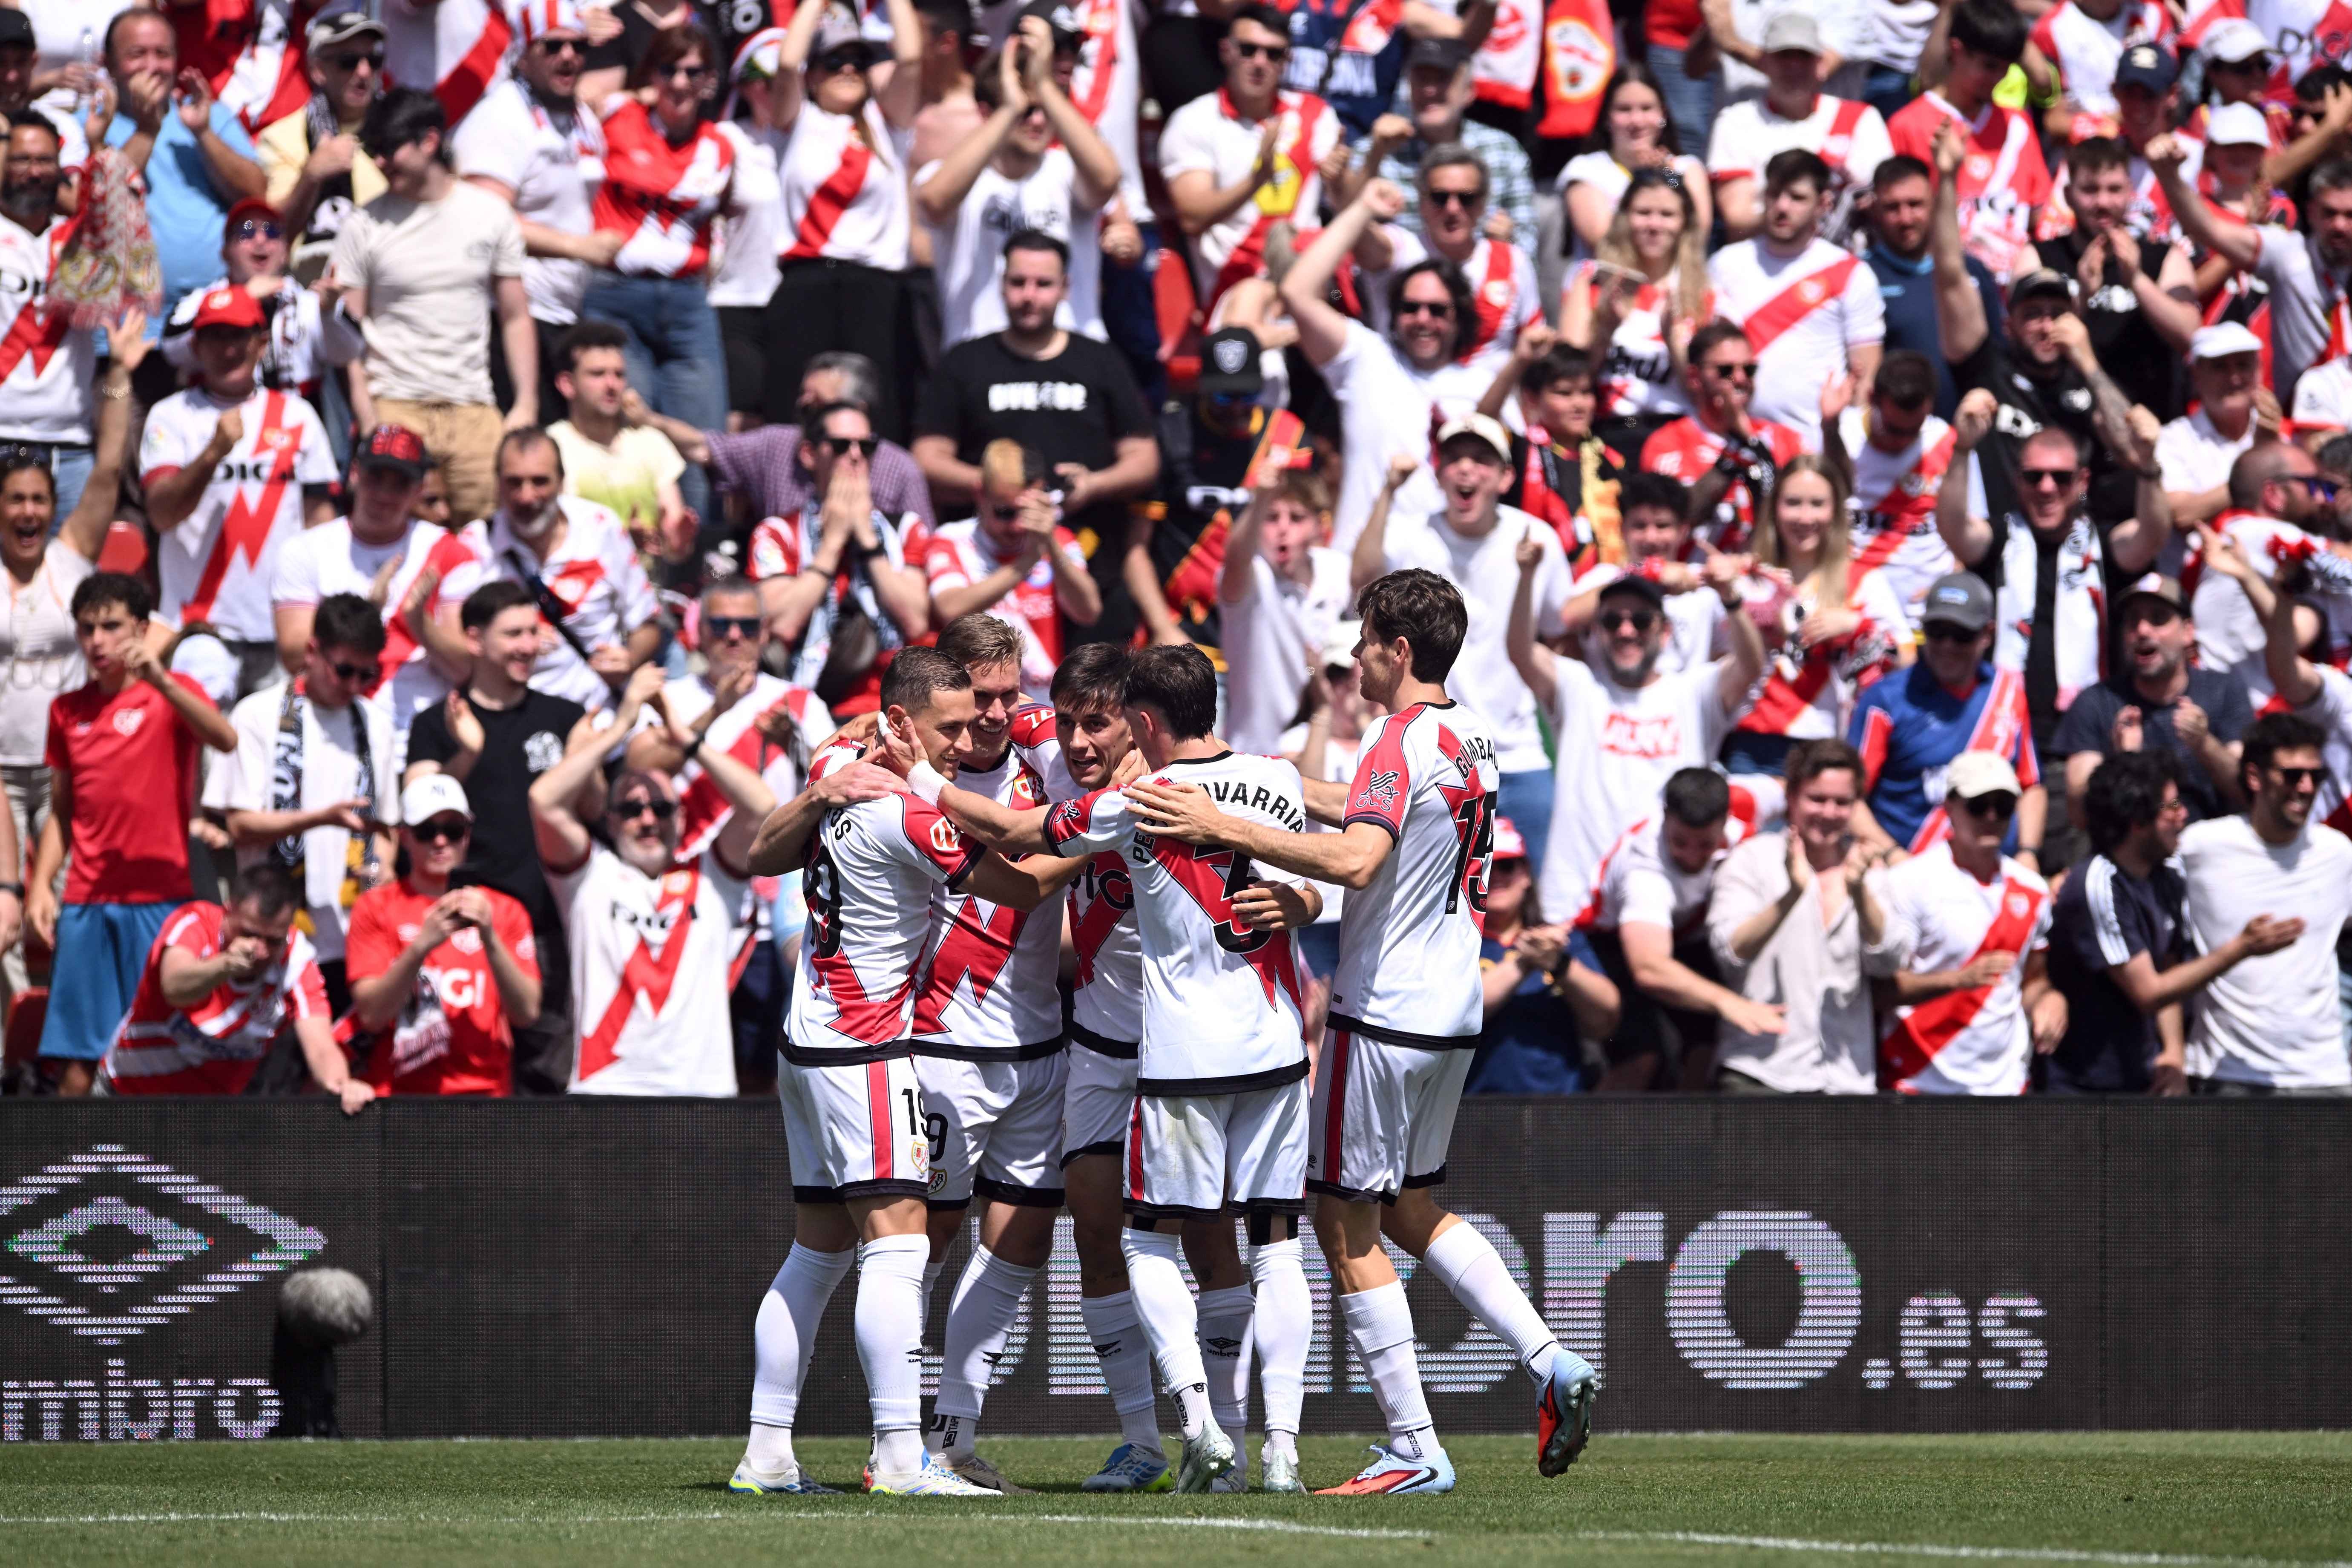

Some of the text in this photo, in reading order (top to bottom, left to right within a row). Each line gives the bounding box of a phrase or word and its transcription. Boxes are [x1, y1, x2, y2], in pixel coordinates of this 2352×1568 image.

[827, 807, 851, 841] OS
[1197, 782, 1303, 833] VARRIA
[1445, 790, 1498, 915] 15
